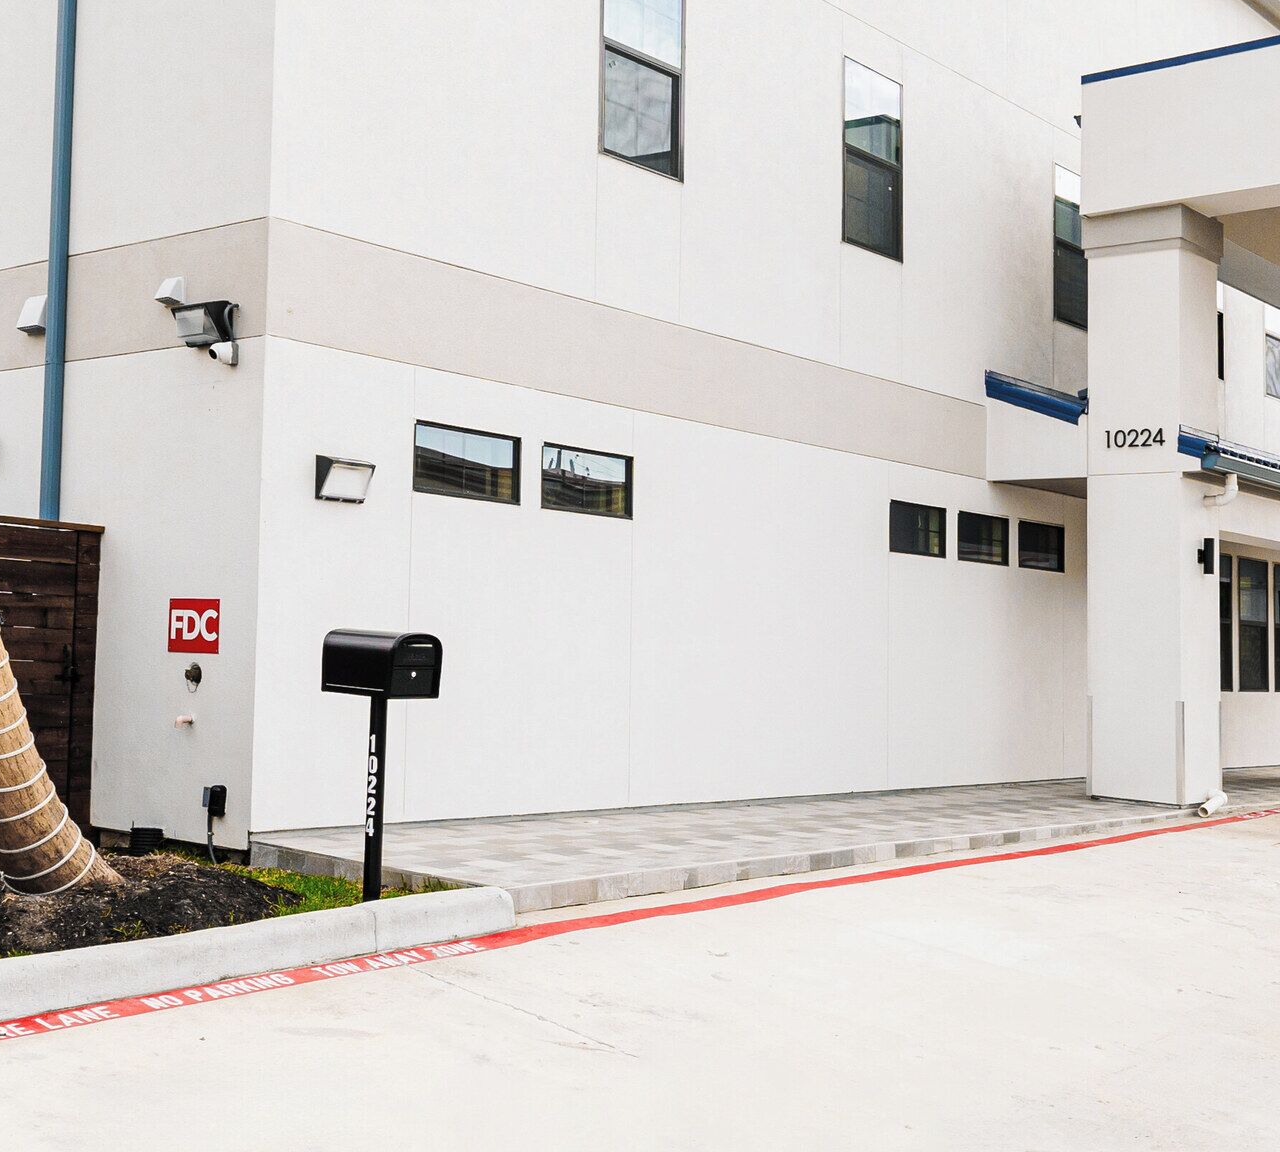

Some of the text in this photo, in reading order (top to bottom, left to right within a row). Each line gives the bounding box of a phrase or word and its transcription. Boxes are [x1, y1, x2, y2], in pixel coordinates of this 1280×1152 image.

[1104, 427, 1166, 449] 10224
[170, 609, 219, 642] FDC
[365, 734, 379, 837] 10224
[34, 1005, 120, 1029] LANE
[140, 994, 184, 1010] NO
[183, 973, 296, 1001] PARKING
[311, 961, 364, 977] TOW
[363, 950, 426, 970] AWAY
[423, 940, 486, 958] ZONE
